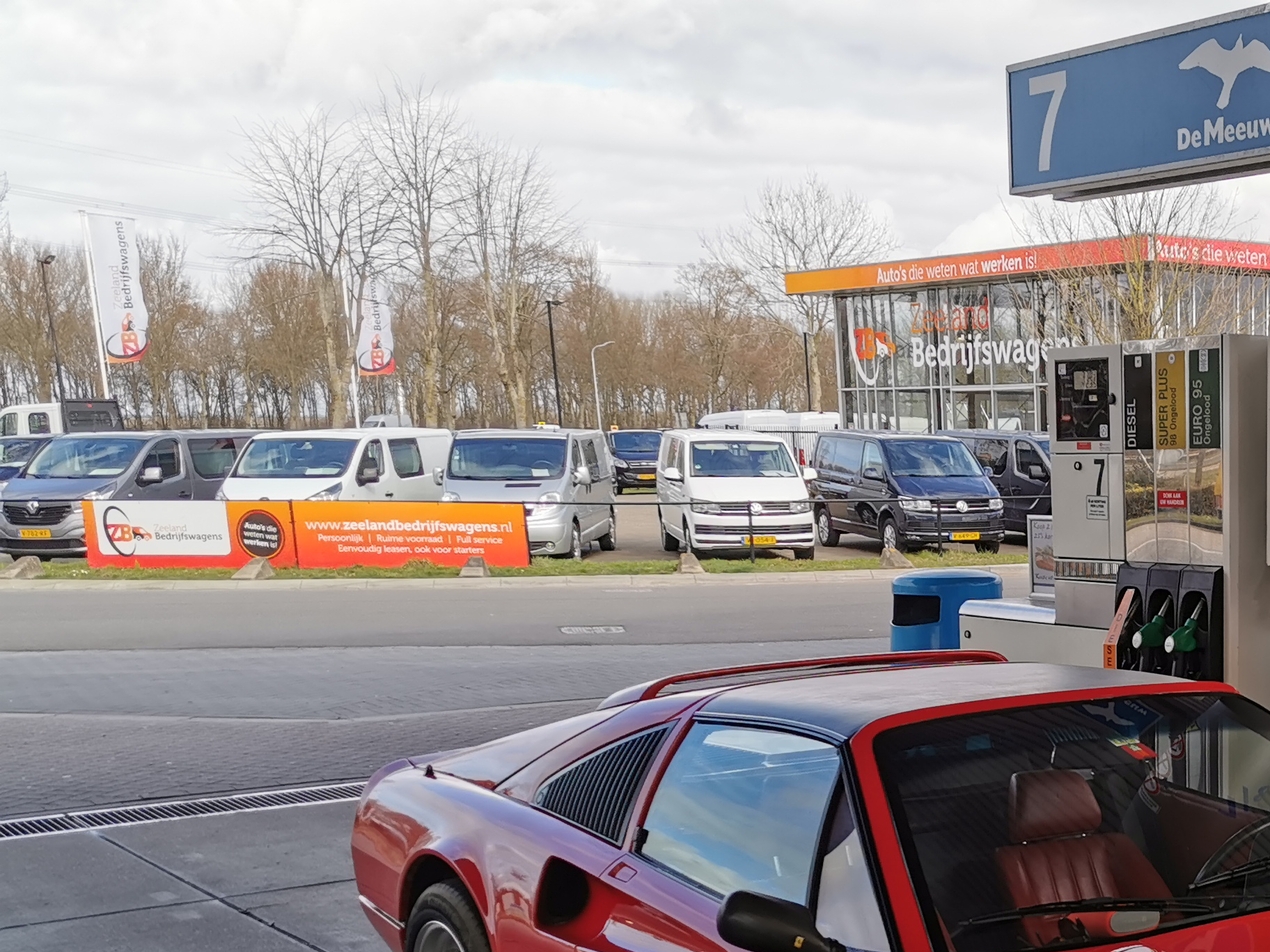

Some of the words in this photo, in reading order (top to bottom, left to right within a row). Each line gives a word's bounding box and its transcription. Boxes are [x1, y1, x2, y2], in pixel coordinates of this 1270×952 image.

[1028, 70, 1067, 172] 7
[115, 220, 134, 309] Bedrijfswagens
[877, 265, 907, 284] Auto's
[908, 263, 924, 281] die
[925, 261, 957, 279] weten
[959, 260, 979, 276] wat
[981, 254, 1022, 273] werken
[1025, 252, 1037, 270] is!
[1202, 244, 1223, 262] die
[1225, 249, 1267, 266] weten
[108, 265, 123, 310] Zeeland
[910, 296, 990, 334] Zeeland
[1158, 368, 1168, 400] PLUS
[1192, 379, 1203, 398] 95
[1127, 398, 1137, 447] DIESEL
[1170, 387, 1178, 430] Ongelood
[1192, 404, 1203, 445] EURO
[1203, 394, 1213, 445] Ongelood
[1158, 405, 1169, 446] SUPER
[1170, 433, 1177, 446] 98
[1094, 459, 1105, 496] 7
[153, 523, 187, 533] Zeeland
[155, 532, 223, 542] Bedrijfswagens
[243, 522, 265, 532] Auto's
[266, 524, 277, 532] die
[243, 538, 270, 548] werken
[305, 520, 513, 534] www.zeelandbedrijfswagens.nl
[318, 534, 364, 544] Persoonlijk
[376, 534, 404, 543] Ruime
[405, 535, 444, 543] voorraad
[456, 535, 472, 544] Full
[473, 536, 503, 545] service
[338, 544, 382, 555] Eenvoudig
[414, 546, 431, 554] ook
[432, 546, 451, 554] voor
[453, 546, 485, 555] starters
